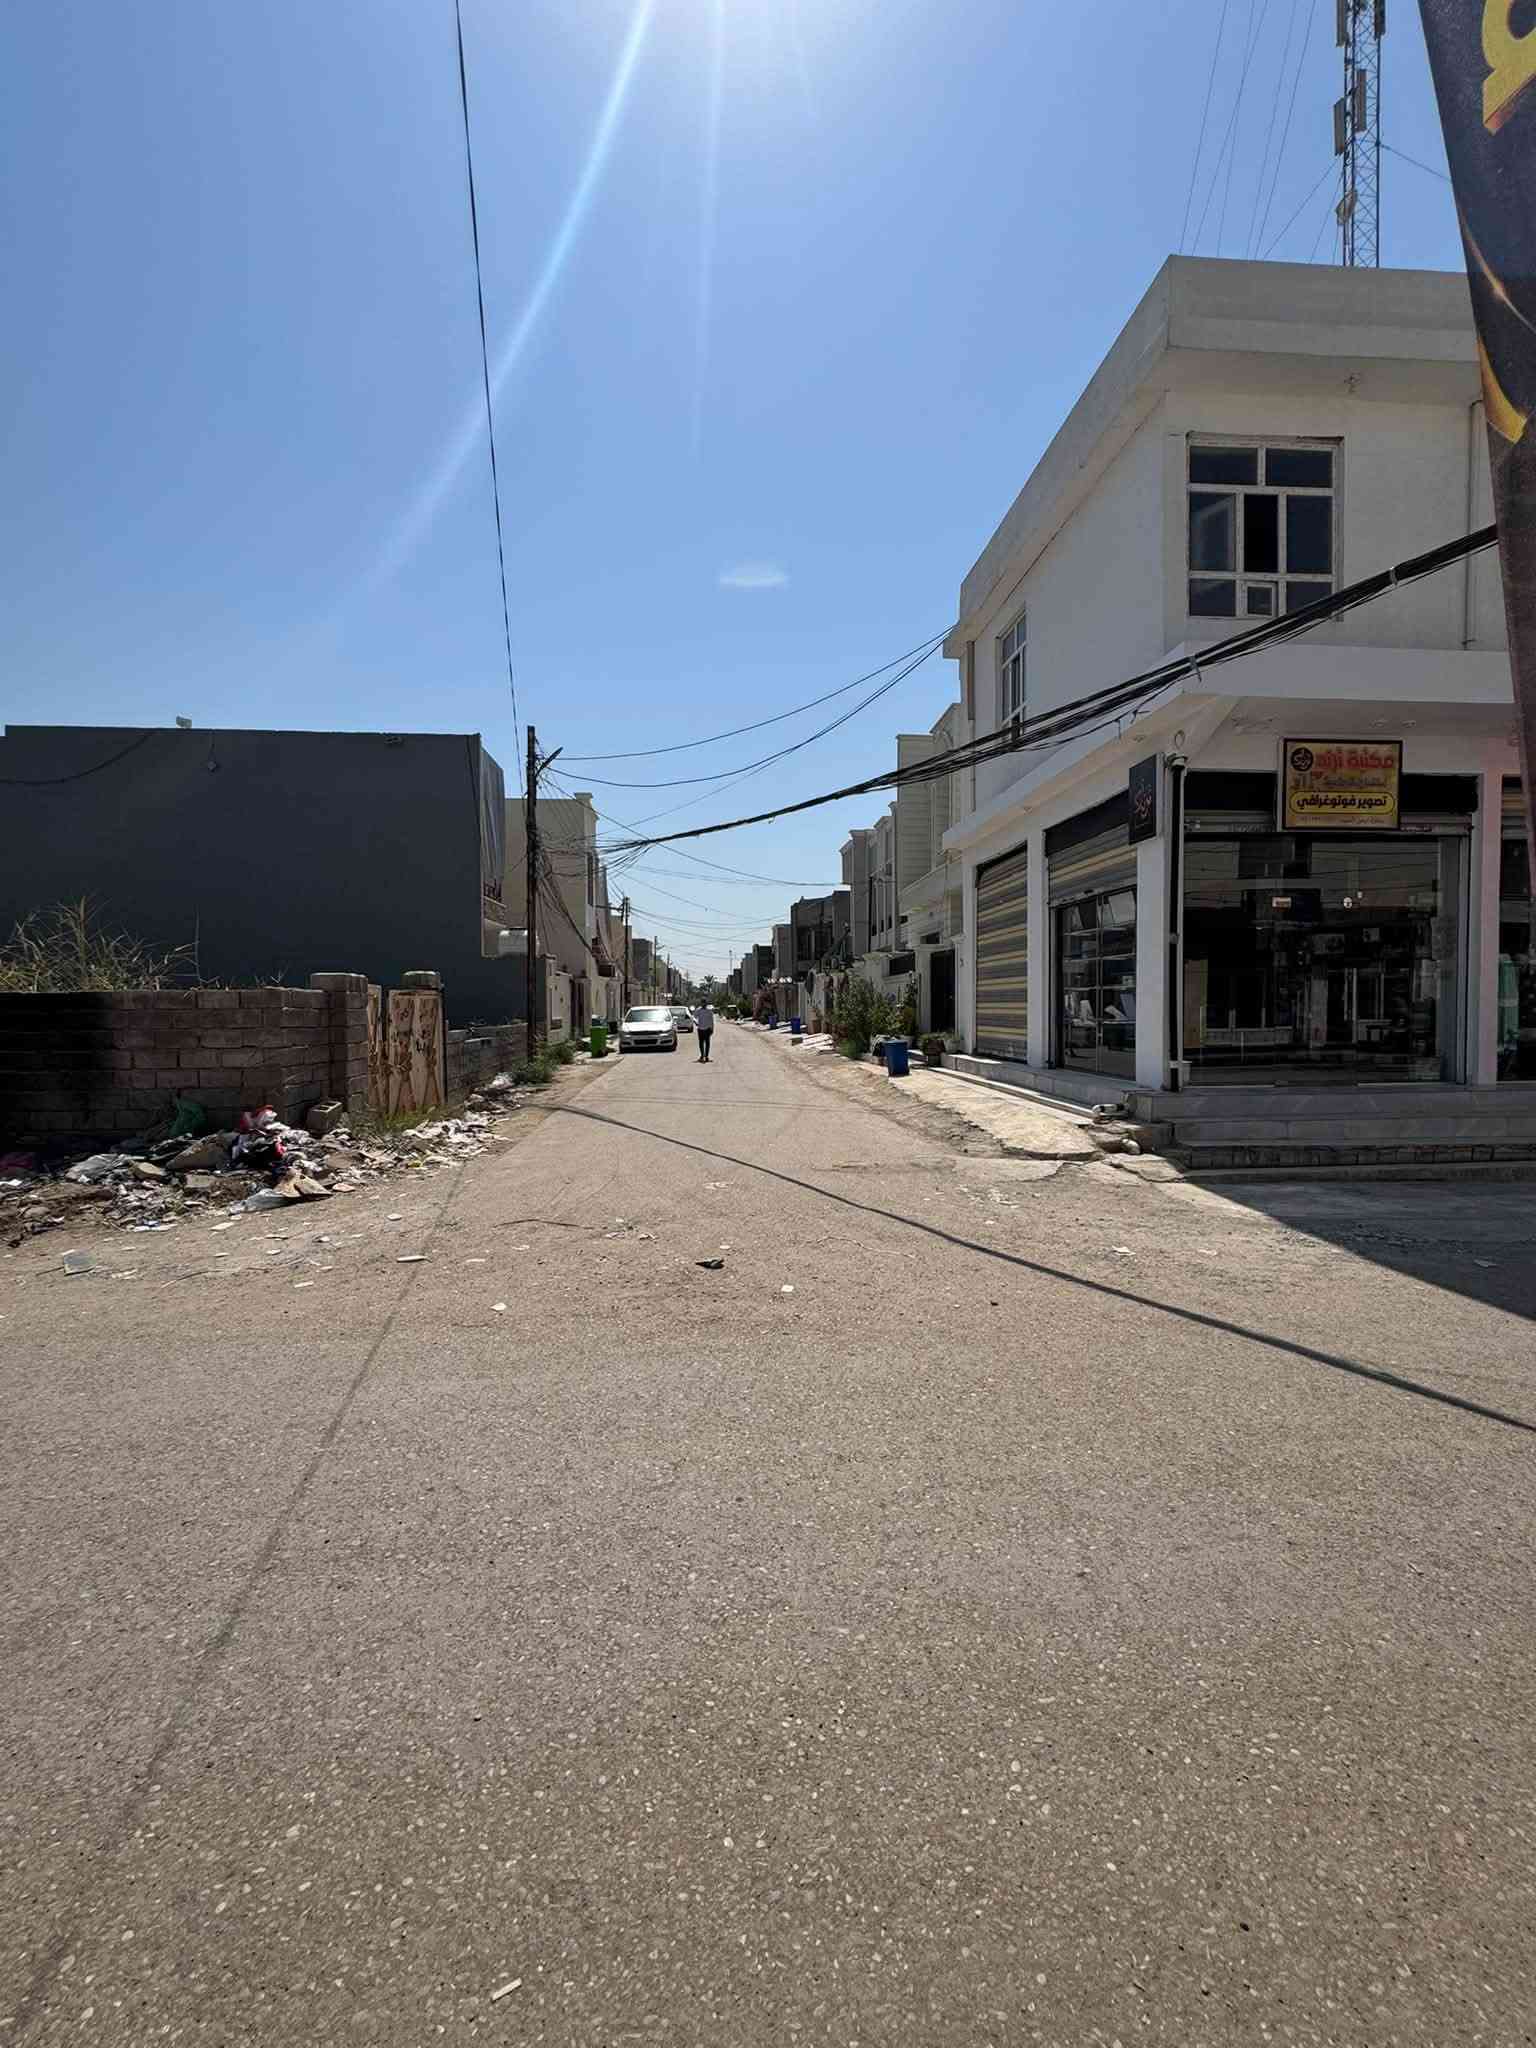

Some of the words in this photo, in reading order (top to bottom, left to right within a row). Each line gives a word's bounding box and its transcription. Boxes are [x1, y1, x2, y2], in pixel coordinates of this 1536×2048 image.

[1345, 748, 1393, 770] مكتبة
[1296, 794, 1357, 810] فوتوغرافي
[1357, 796, 1387, 809] تصوير
